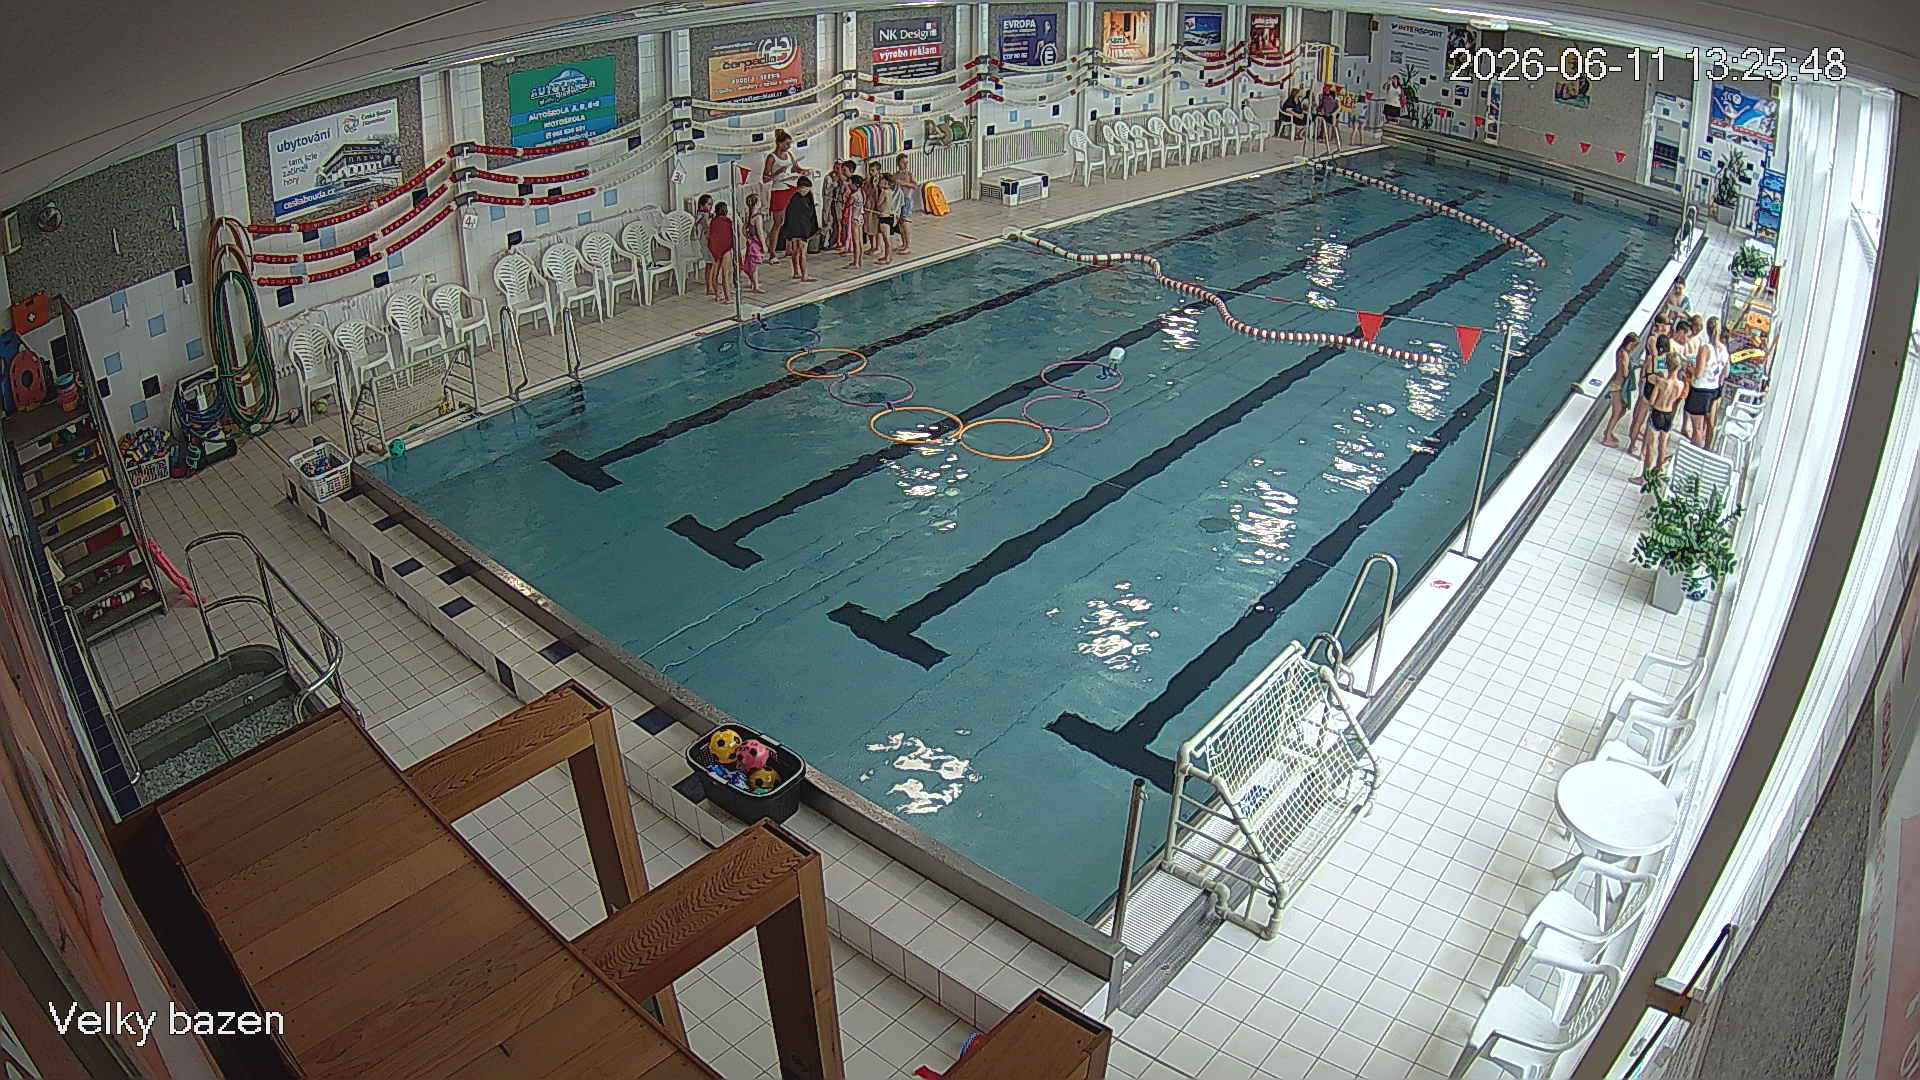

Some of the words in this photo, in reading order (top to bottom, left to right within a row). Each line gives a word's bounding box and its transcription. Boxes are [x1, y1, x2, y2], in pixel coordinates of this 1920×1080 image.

[1003, 19, 1036, 29] EVROPA
[1398, 24, 1442, 37] INTERSPORT
[879, 28, 898, 41] NK
[900, 25, 936, 40] Design
[909, 45, 937, 57] reklam
[276, 127, 332, 153] ubytování
